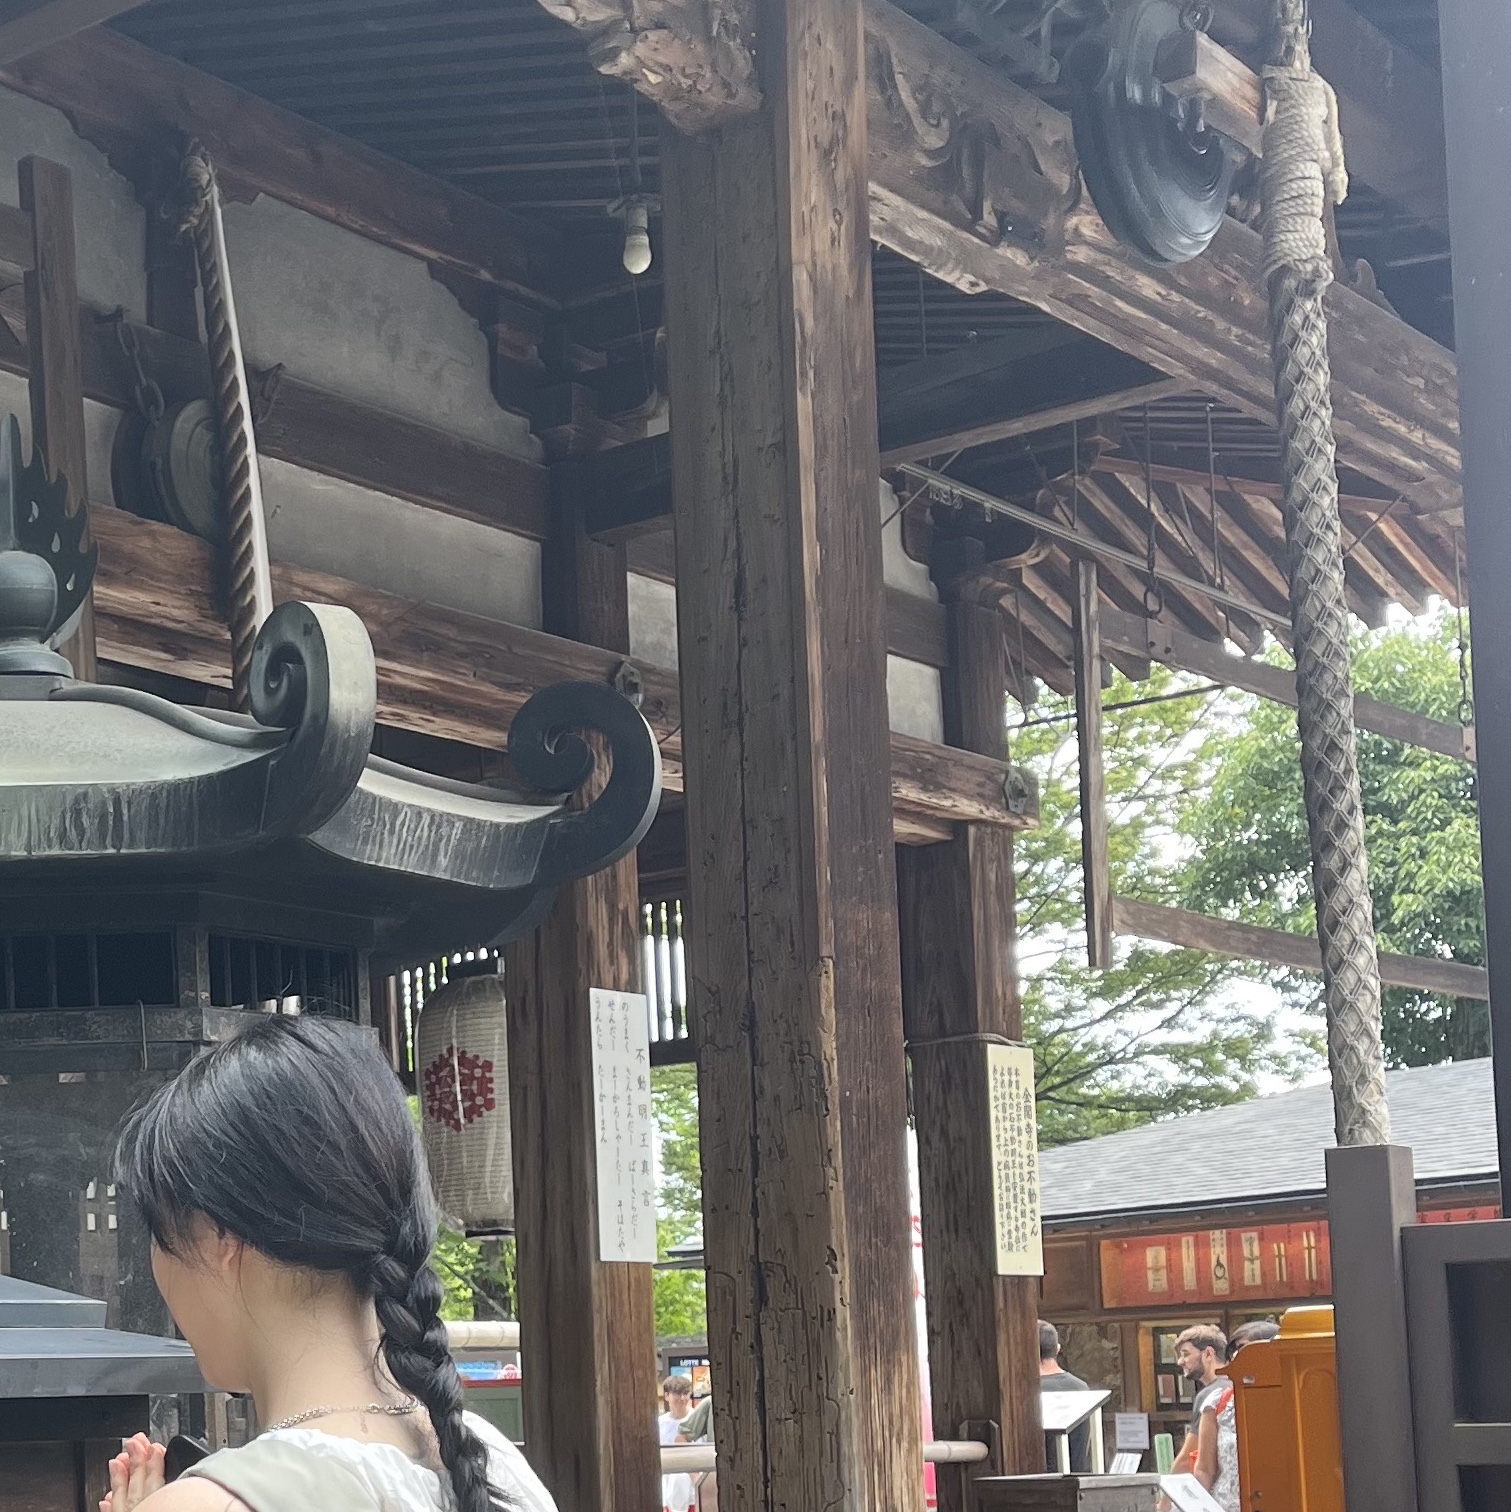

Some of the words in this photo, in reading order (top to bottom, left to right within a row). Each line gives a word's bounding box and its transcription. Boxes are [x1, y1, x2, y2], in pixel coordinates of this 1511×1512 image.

[636, 1048, 650, 1207] 不動明王真言
[1022, 1087, 1039, 1237] 金閣寺のお不動さん
